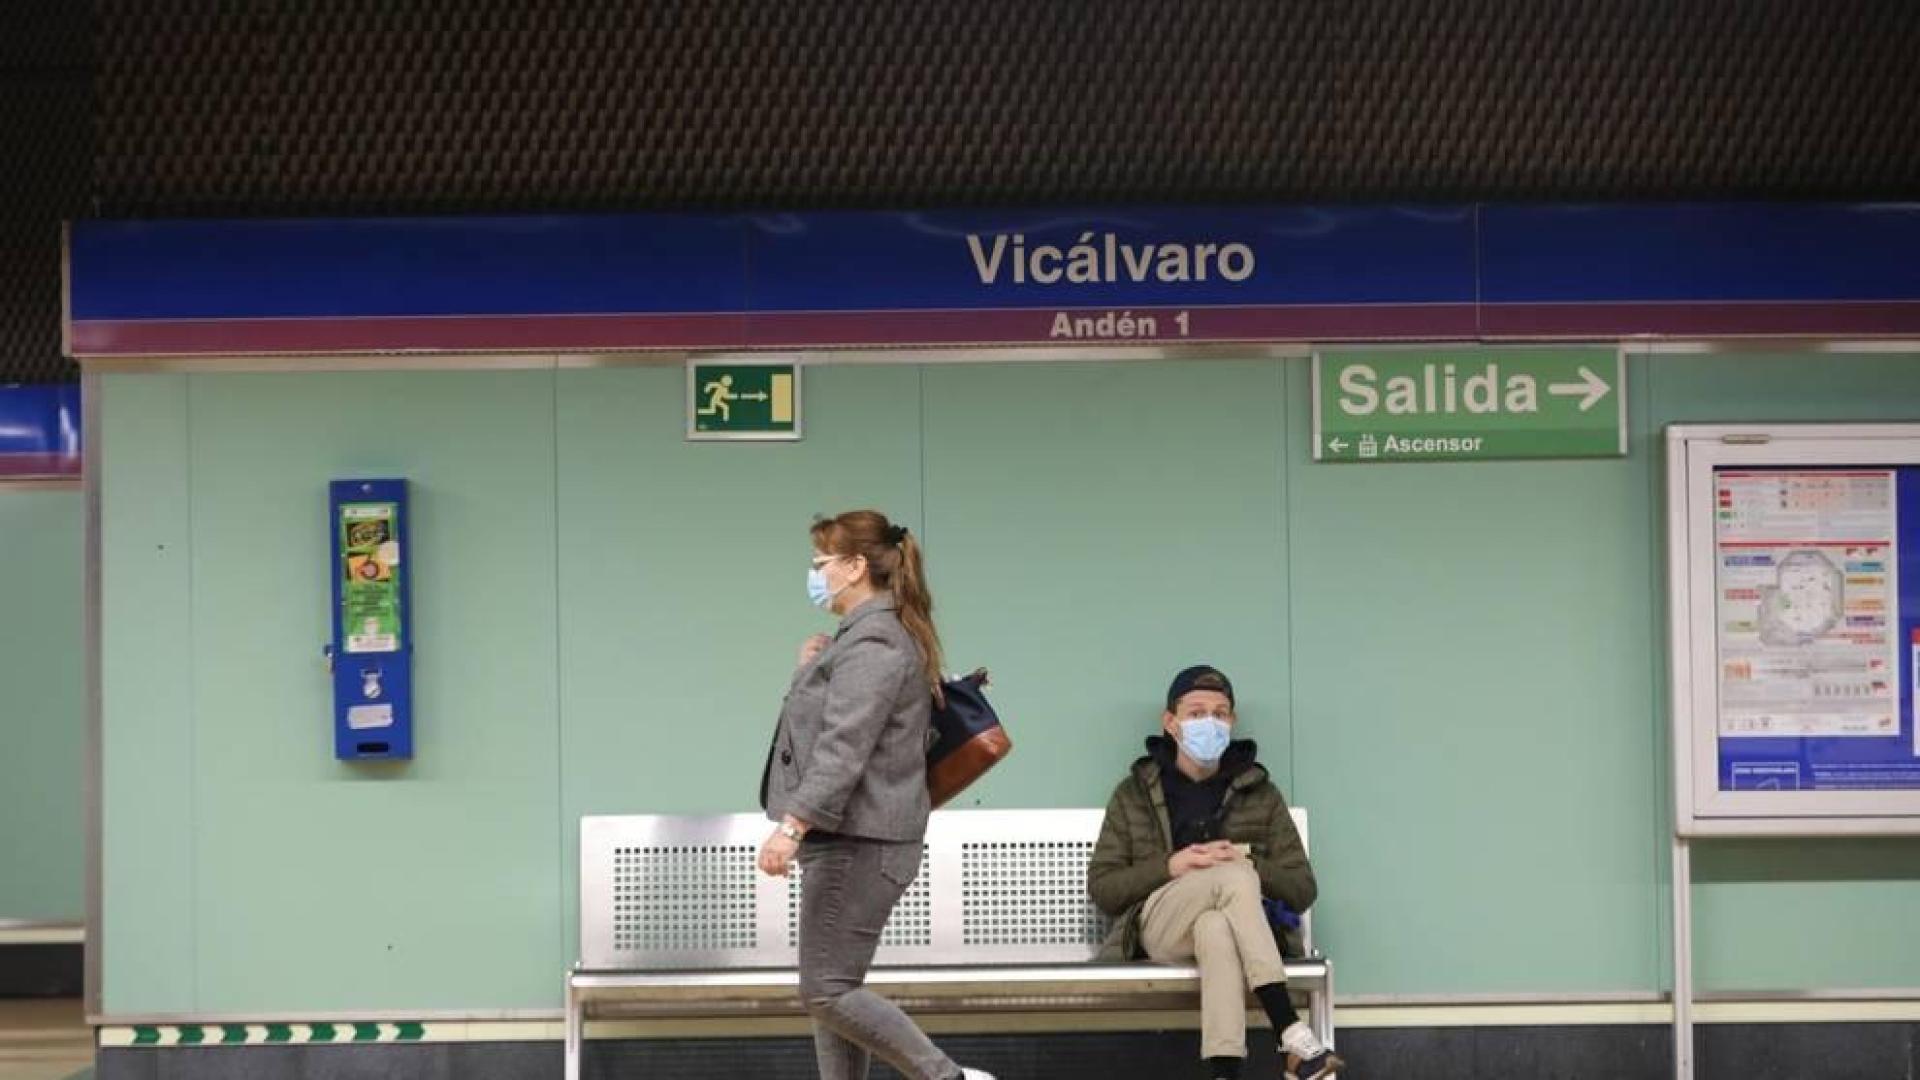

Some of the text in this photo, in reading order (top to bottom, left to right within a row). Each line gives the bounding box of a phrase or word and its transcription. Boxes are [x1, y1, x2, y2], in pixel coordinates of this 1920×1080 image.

[967, 232, 1256, 284] Vicálvaro
[1050, 311, 1191, 338] Andén 1
[1338, 363, 1538, 416] Salida
[1384, 434, 1482, 453] Ascensor
